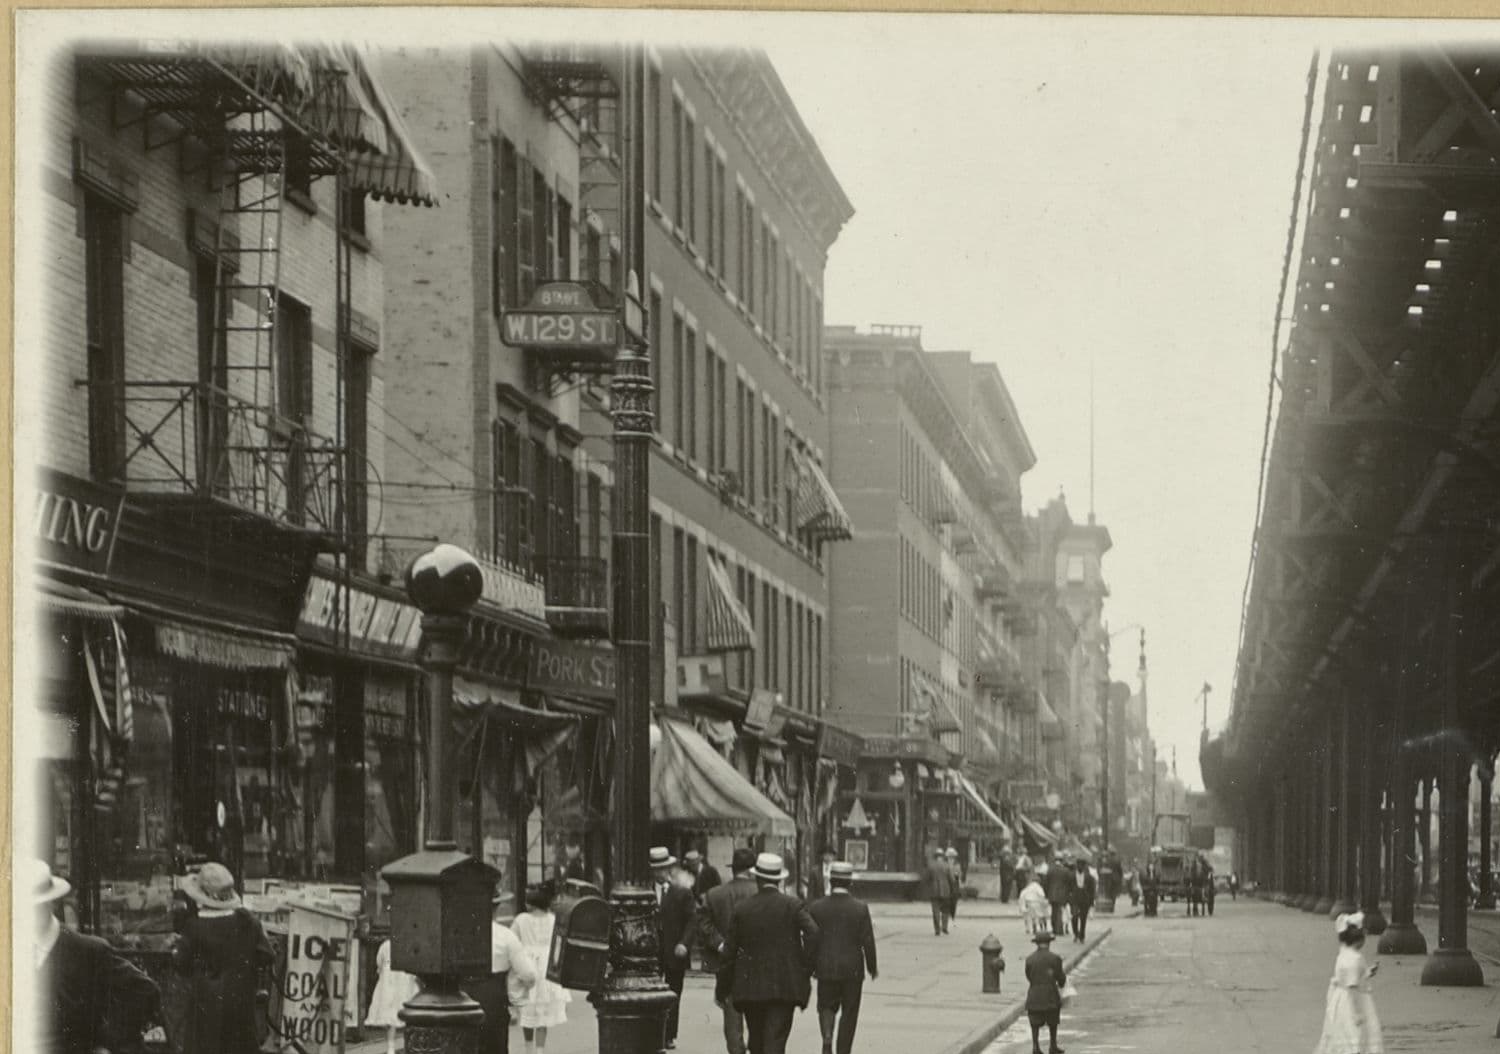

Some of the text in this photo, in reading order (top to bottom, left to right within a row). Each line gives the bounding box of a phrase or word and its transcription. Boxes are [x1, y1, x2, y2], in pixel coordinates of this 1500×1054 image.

[38, 491, 110, 552] ING
[536, 647, 585, 684] PORK
[291, 934, 348, 962] ICE
[286, 971, 345, 1000] COAL
[282, 1015, 342, 1046] WOOD
